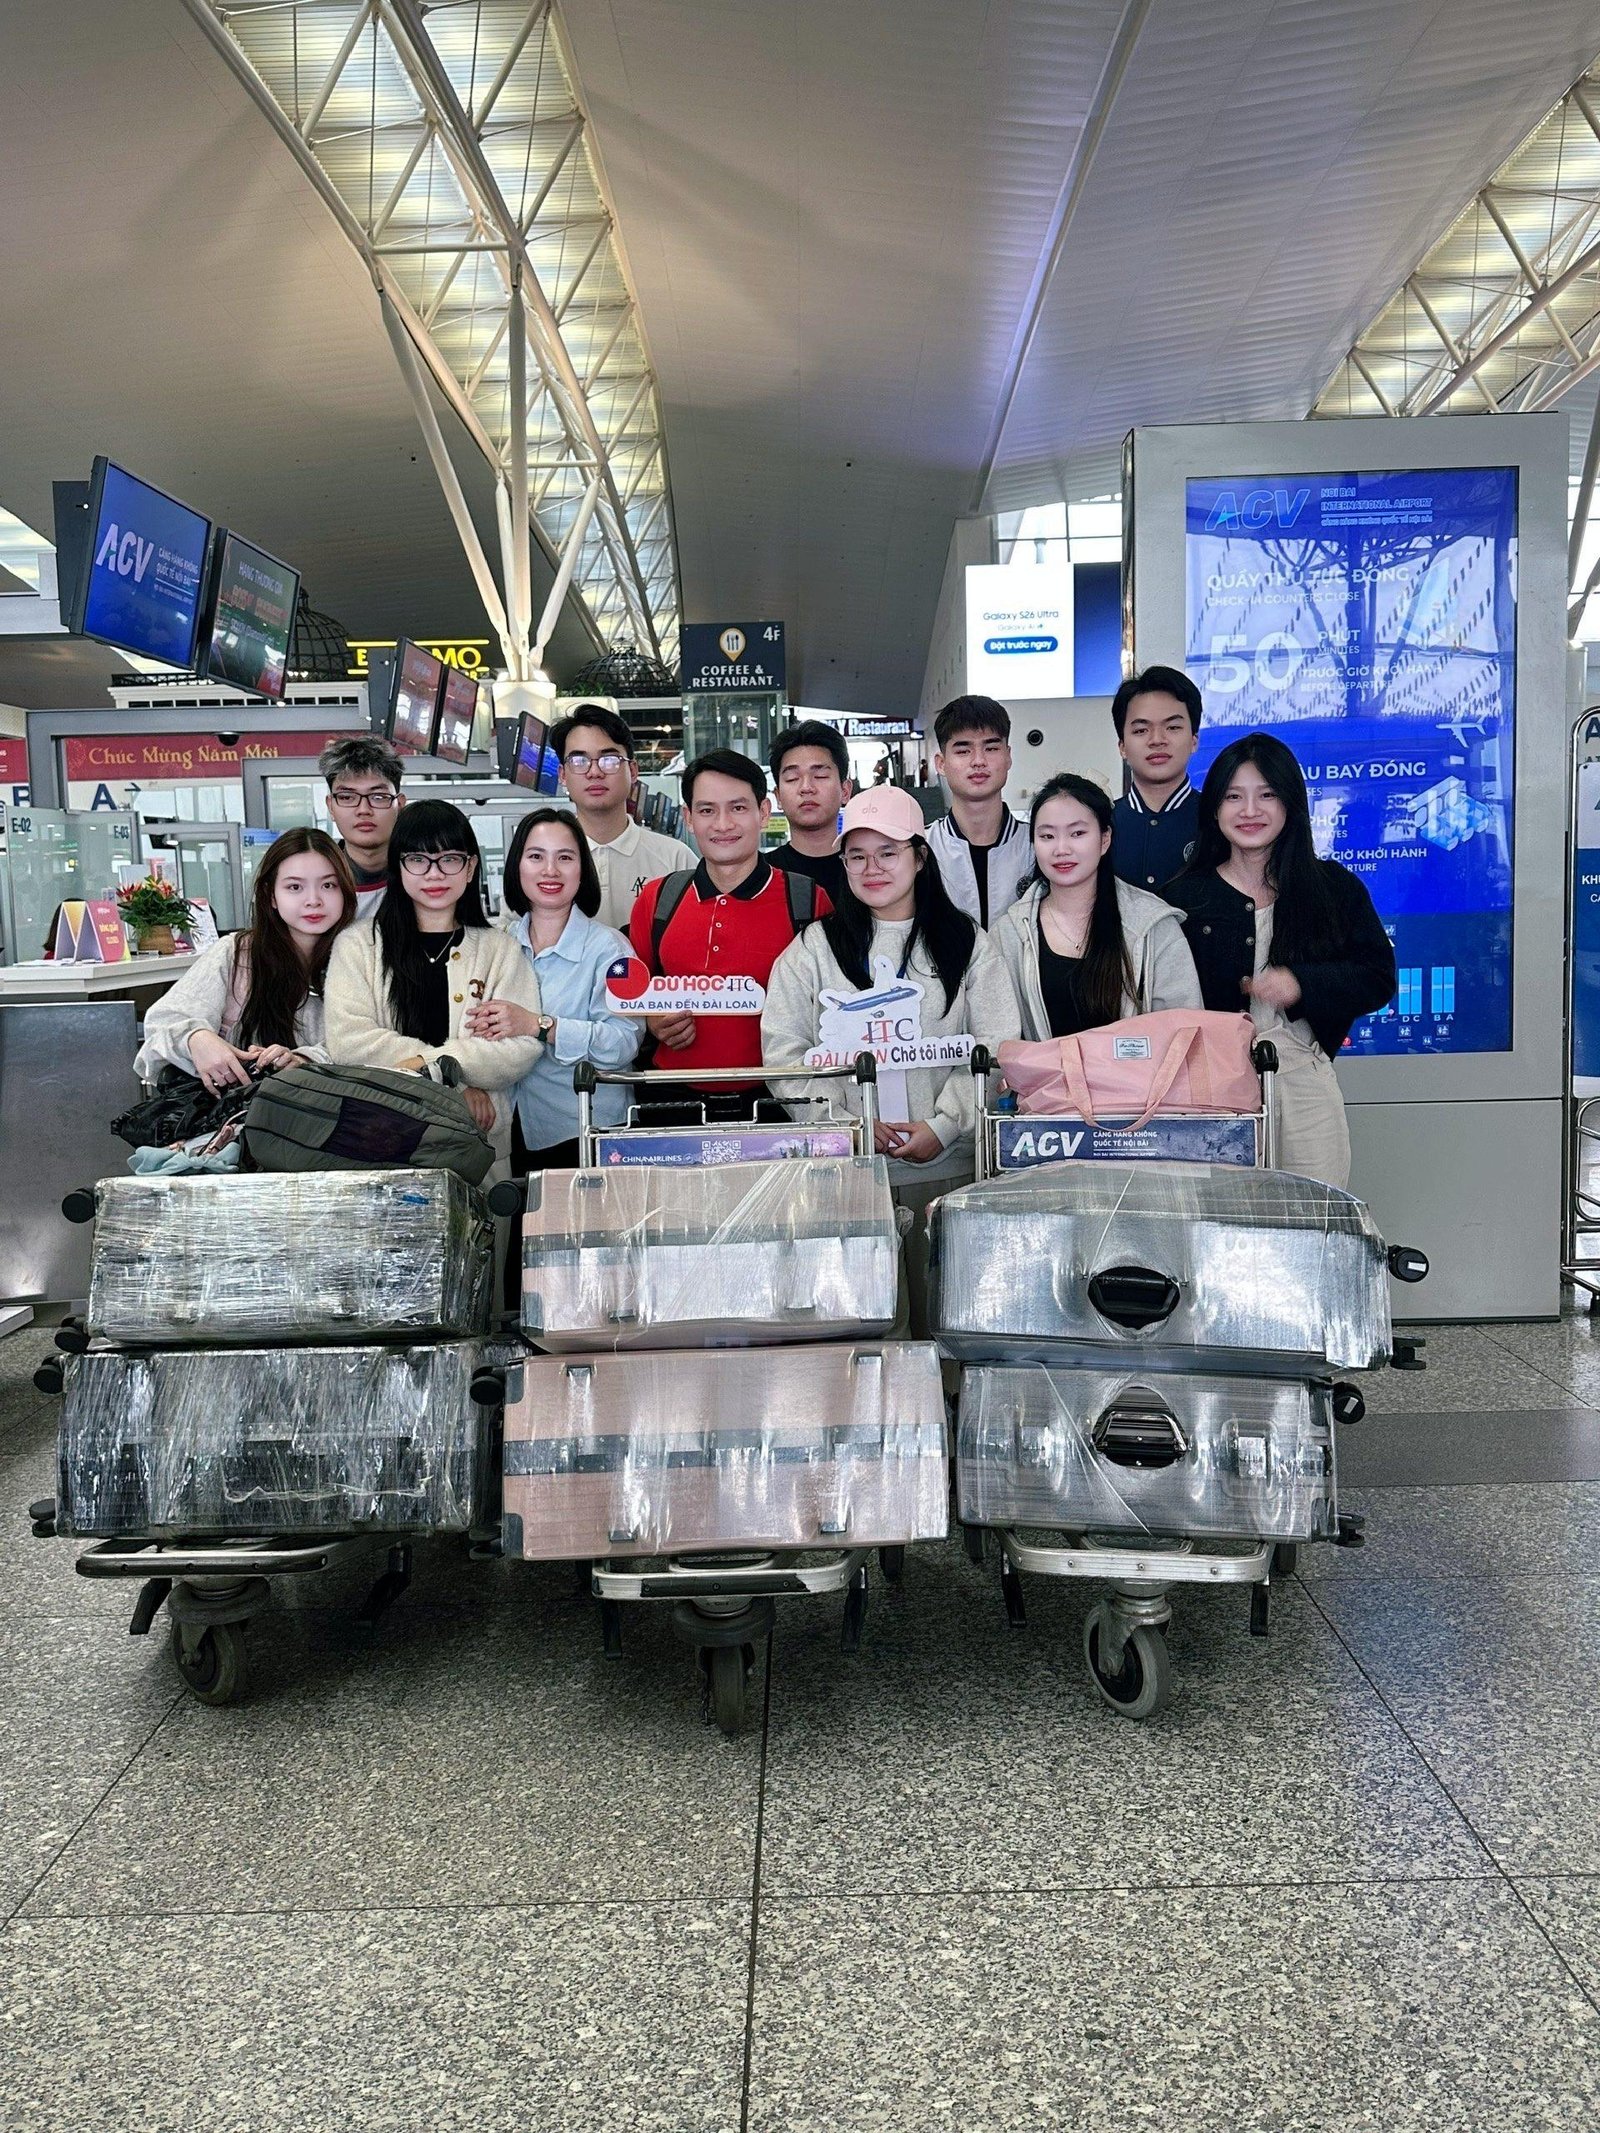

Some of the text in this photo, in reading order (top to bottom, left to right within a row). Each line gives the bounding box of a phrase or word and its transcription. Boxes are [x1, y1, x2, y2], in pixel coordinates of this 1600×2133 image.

[1340, 487, 1356, 497] BAI
[1205, 489, 1310, 531] ACV
[1321, 498, 1432, 511] INTERNATIONAL AIRPORT
[96, 523, 154, 583] ACV
[1325, 591, 1360, 602] CLOSE
[983, 610, 1059, 621] Galaxy S26 Ultra
[763, 626, 780, 641] 4F
[1318, 628, 1361, 642] PHÚT
[1318, 645, 1360, 655] MINUTES
[1205, 631, 1301, 693] 50
[701, 664, 764, 676] COFFEE &
[1346, 664, 1370, 677] GIỜ
[692, 675, 774, 688] RESTAURANT
[848, 718, 910, 736] Restaurant
[89, 743, 279, 770] Chúc Mừng Năm Mới
[1326, 764, 1364, 779] BAY
[1369, 759, 1426, 778] ĐÓNG
[91, 783, 118, 811] A
[12, 817, 31, 832] E-02
[113, 826, 129, 839] E-03
[1331, 848, 1354, 861] GIỜ
[1357, 846, 1388, 859] KHỞI
[1391, 846, 1427, 859] HÀNH
[1582, 874, 1600, 885] KH
[653, 977, 755, 995] DU HỌC ITC
[620, 998, 757, 1011] ĐƯA BẠN ĐẾN ĐÀI LOAN
[1402, 1015, 1410, 1023] D
[1434, 1014, 1441, 1022] B
[1446, 1013, 1454, 1021] A
[865, 1018, 915, 1044] ITC
[811, 1049, 839, 1067] ĐÀI
[890, 1045, 916, 1063] Chờ
[919, 1044, 937, 1061] tôi
[940, 1039, 963, 1059] nhé
[966, 1041, 970, 1057] !
[1133, 1130, 1158, 1138] KHÔNG
[1010, 1131, 1085, 1157] ACV
[1093, 1138, 1112, 1147] QUỐC
